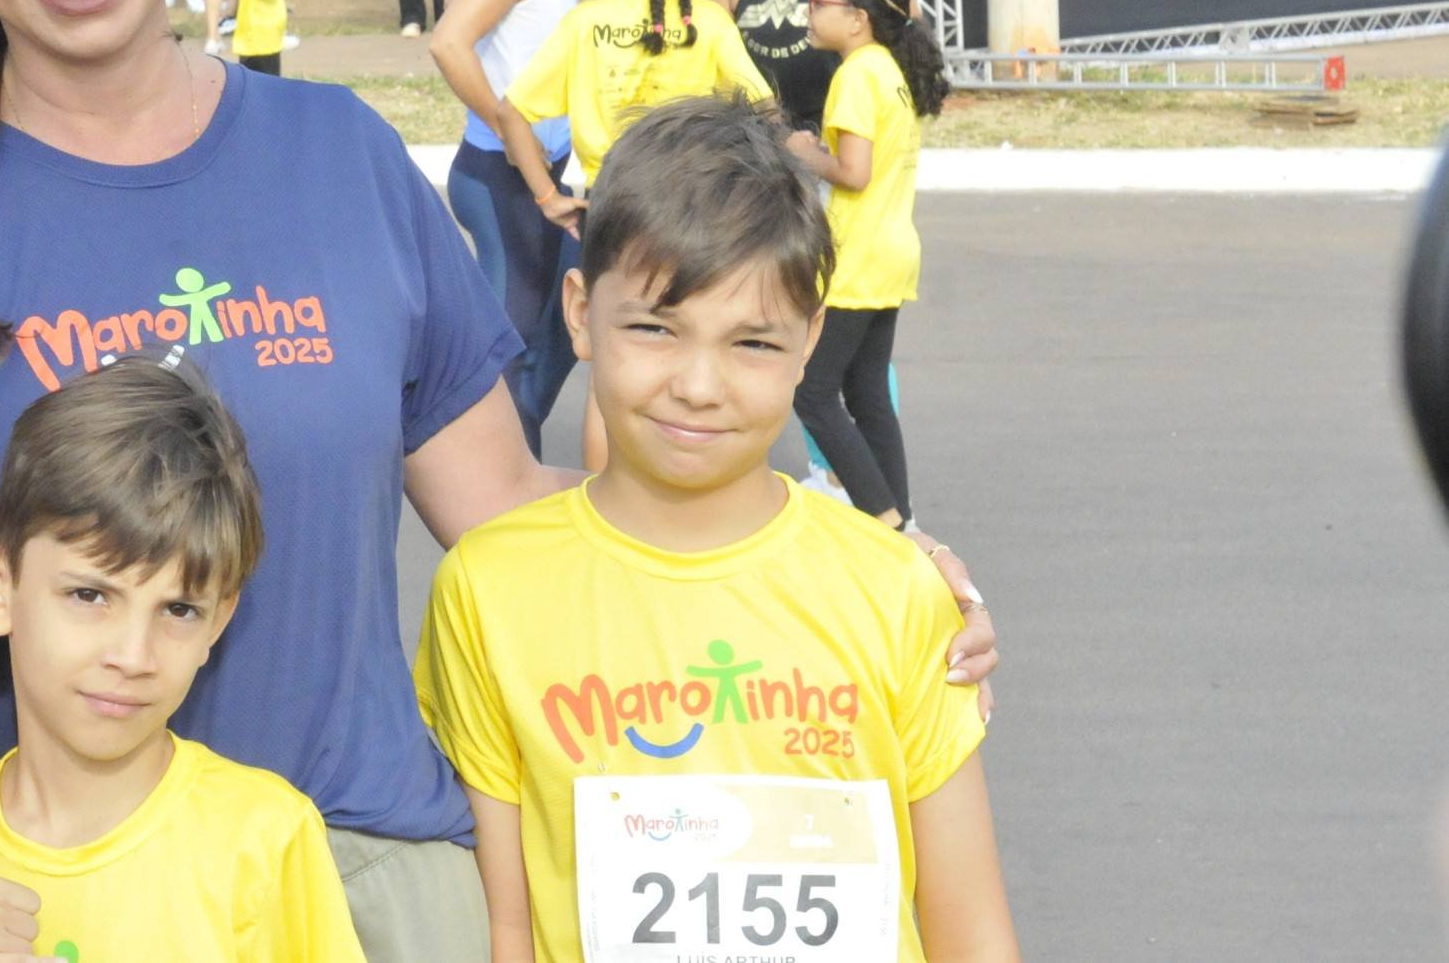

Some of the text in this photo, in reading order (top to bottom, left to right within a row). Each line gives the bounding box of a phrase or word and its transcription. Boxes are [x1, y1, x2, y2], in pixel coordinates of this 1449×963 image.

[255, 337, 334, 367] 2025
[783, 727, 856, 760] 2025
[631, 871, 840, 947] 2155
